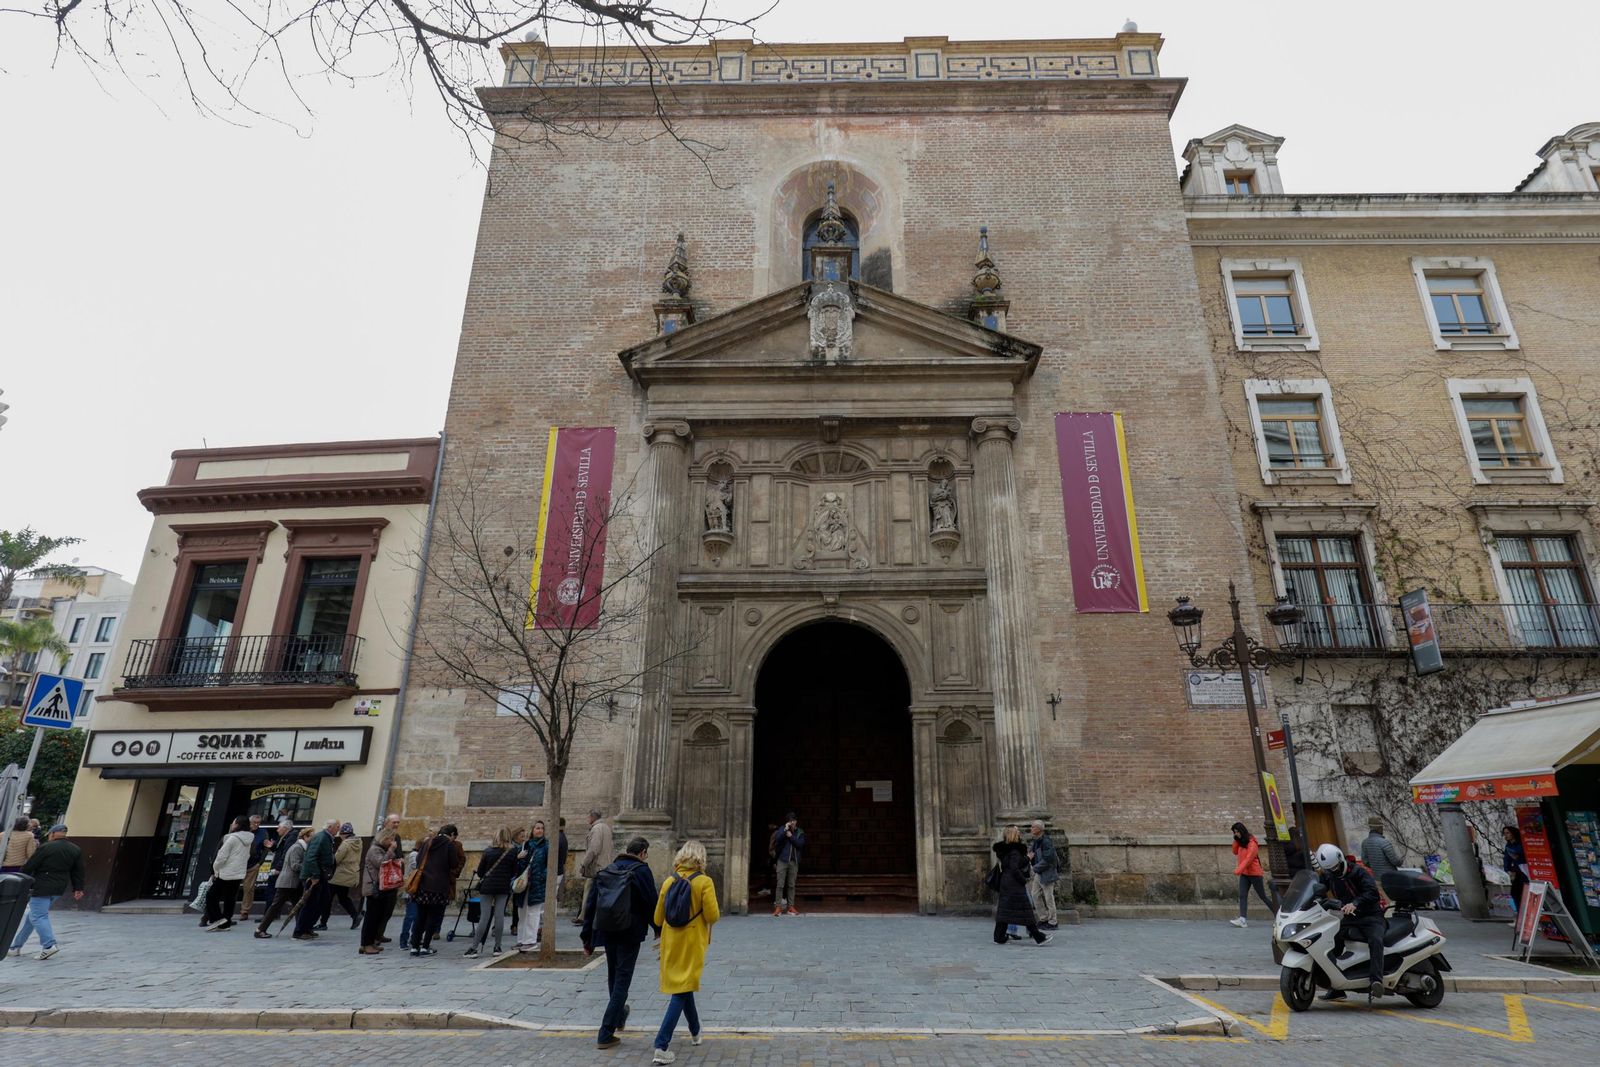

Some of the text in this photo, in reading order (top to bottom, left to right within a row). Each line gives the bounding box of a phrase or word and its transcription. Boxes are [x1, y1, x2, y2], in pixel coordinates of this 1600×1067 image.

[576, 447, 592, 488] SEVILLA
[1082, 430, 1098, 472] SEVILLA
[567, 501, 586, 575] UNIVERSIDAD
[1089, 485, 1109, 561] UNIVERSIDAD
[197, 734, 267, 750] SQUARE
[219, 751, 244, 760] CAKE
[246, 751, 253, 759] &
[304, 737, 345, 750] LAVAZZA
